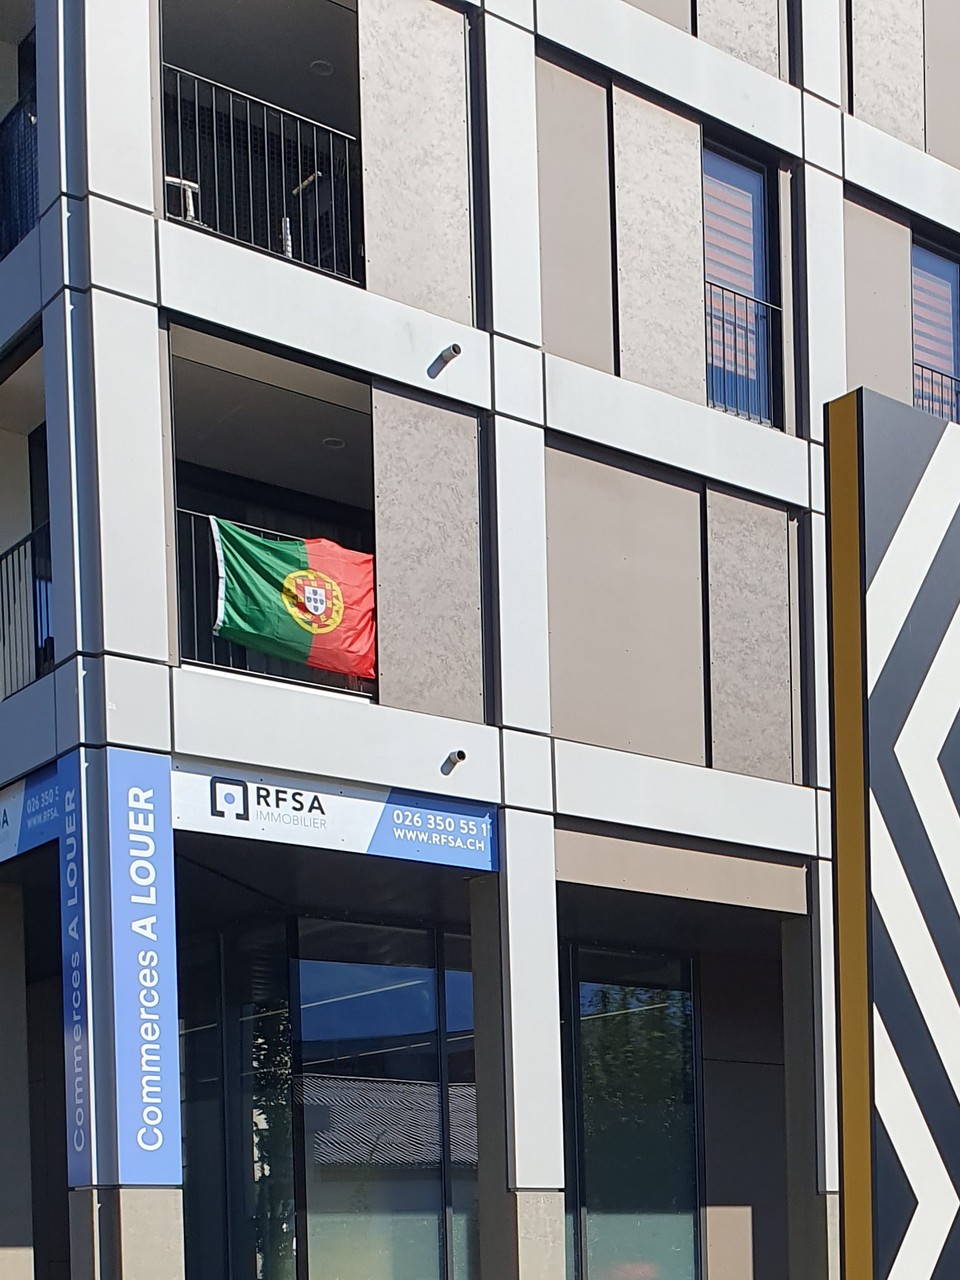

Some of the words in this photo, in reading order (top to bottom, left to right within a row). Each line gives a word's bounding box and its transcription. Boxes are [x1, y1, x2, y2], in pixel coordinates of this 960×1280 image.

[256, 786, 326, 815] RFSA
[256, 810, 327, 830] IMMOBILIER
[393, 809, 422, 827] 026
[426, 814, 455, 832] 350
[459, 819, 477, 836] 55
[65, 788, 78, 906] LOUER
[128, 786, 157, 905] LOUER
[393, 827, 485, 852] WWW.RFSA.CH
[68, 915, 79, 940] A
[131, 915, 158, 942] A
[73, 951, 85, 1152] Commerces
[136, 950, 164, 1152] Commerces
